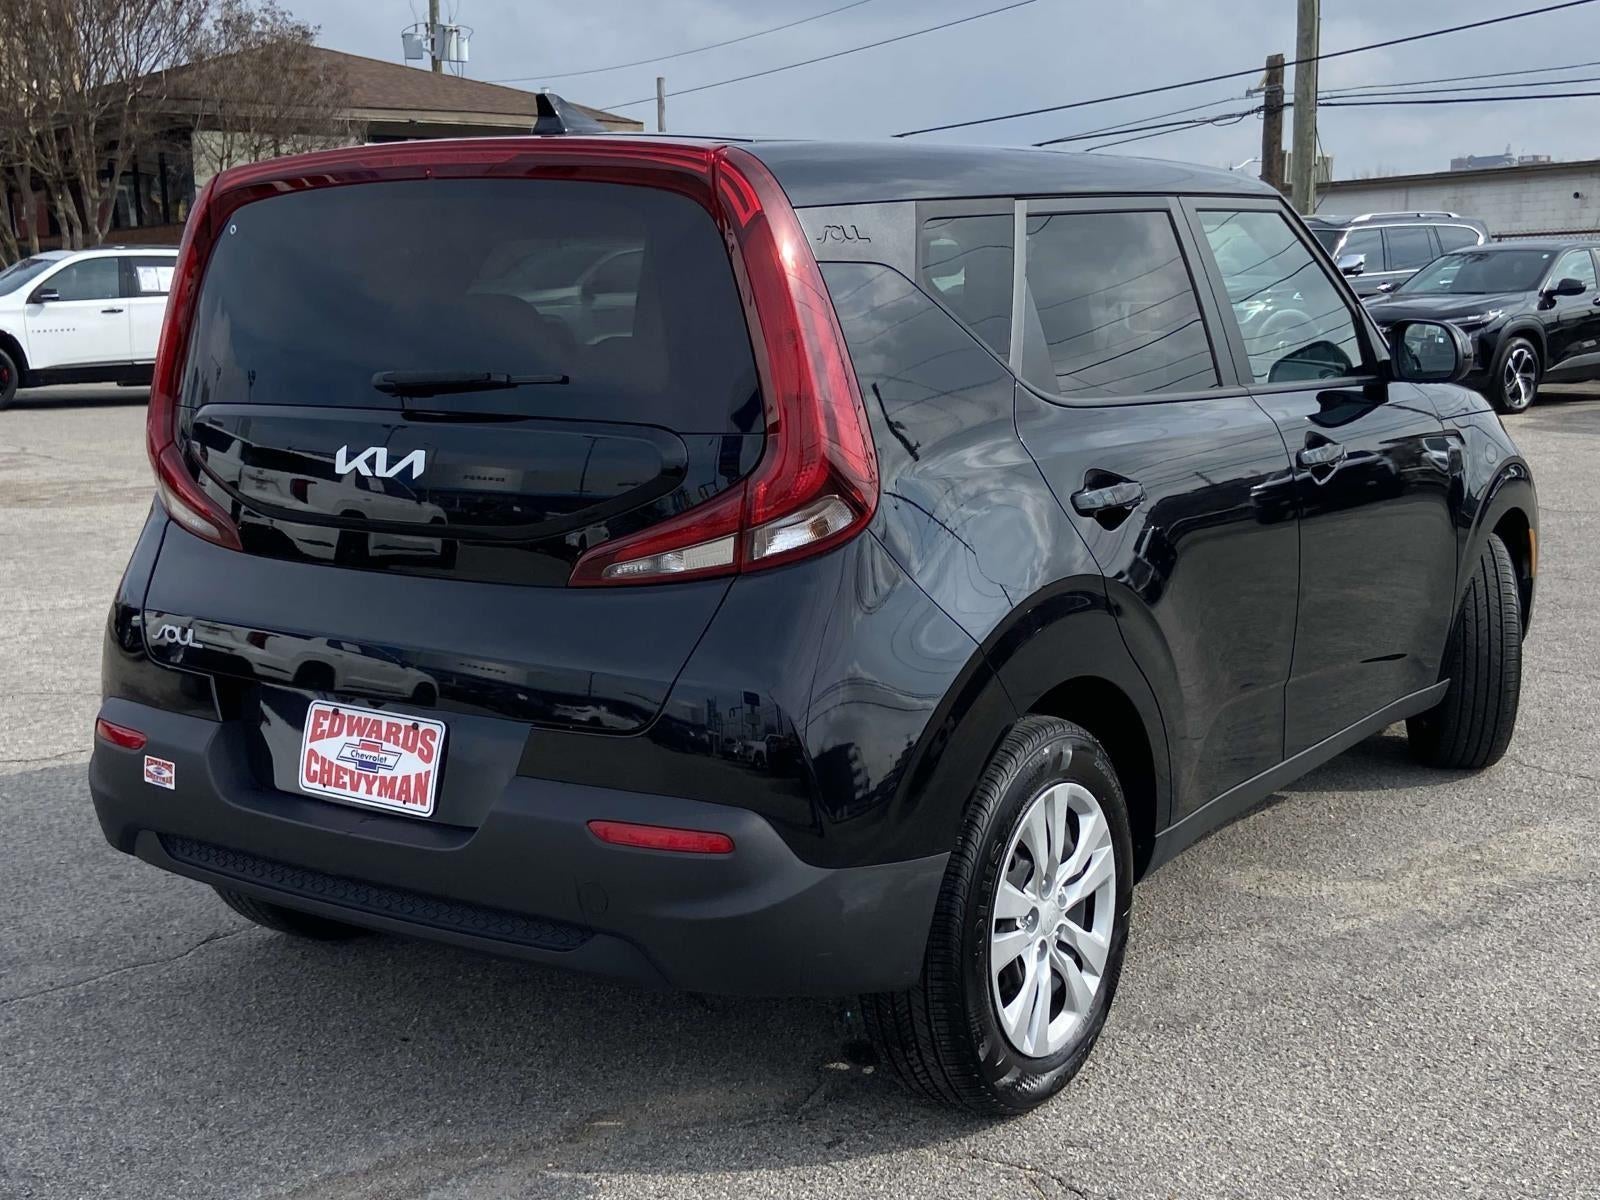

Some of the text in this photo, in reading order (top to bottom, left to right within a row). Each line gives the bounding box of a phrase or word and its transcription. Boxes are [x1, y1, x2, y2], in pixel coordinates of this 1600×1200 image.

[816, 225, 871, 244] SOUL
[335, 444, 426, 480] KIA
[152, 624, 204, 649] SOUL
[309, 709, 437, 764] EDWARDS
[350, 749, 388, 764] Chevrolet
[305, 748, 431, 806] CHEVYMAN
